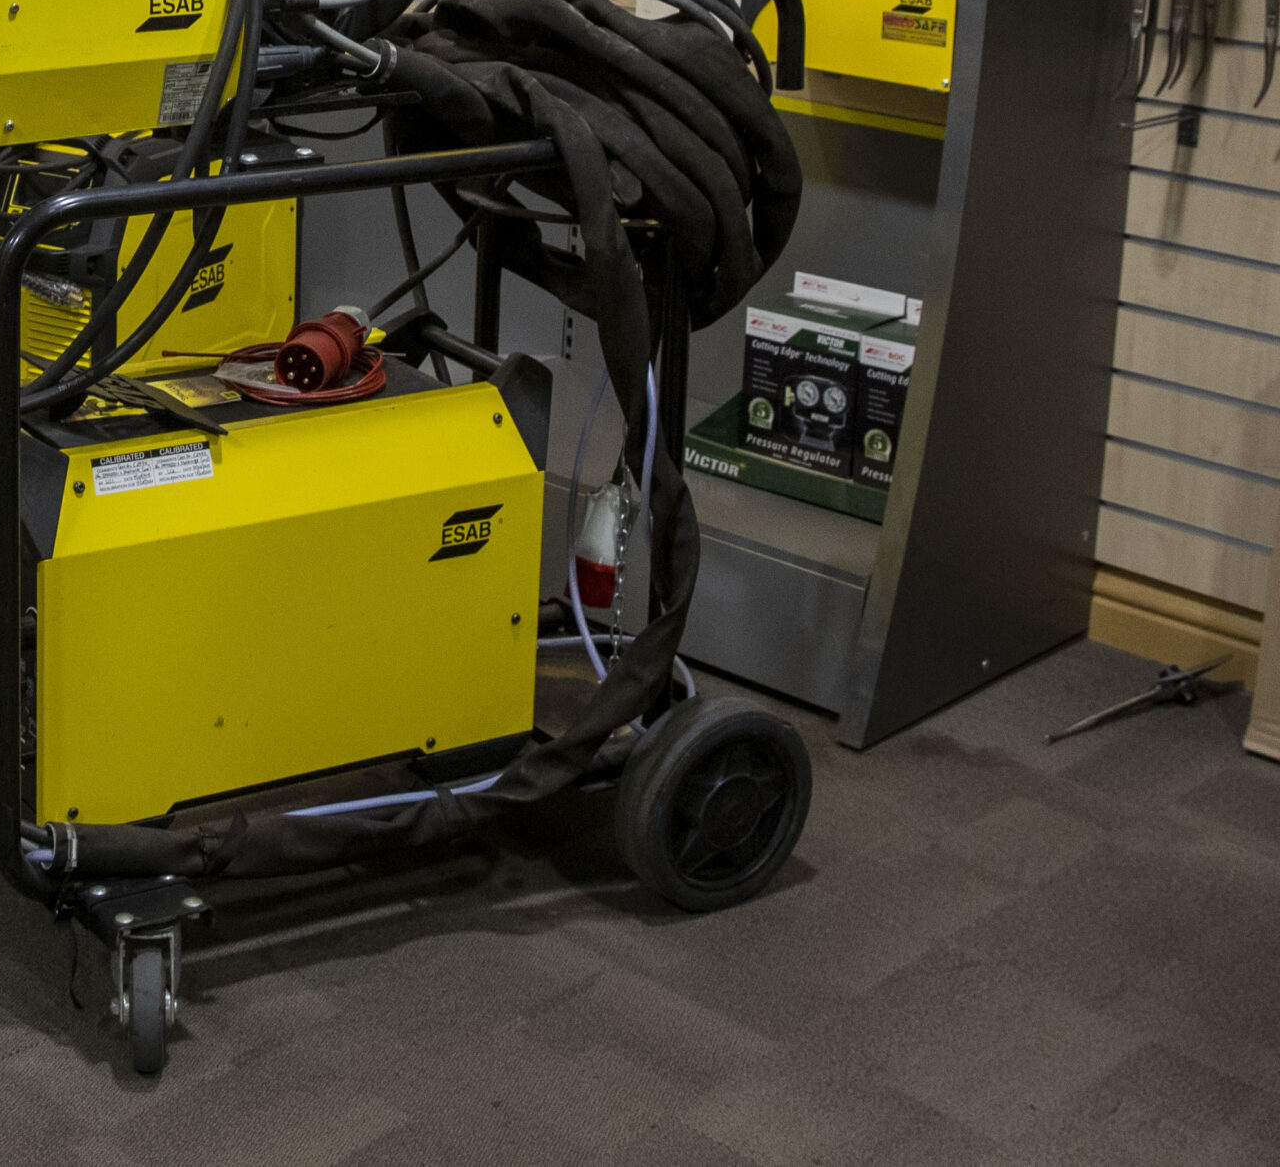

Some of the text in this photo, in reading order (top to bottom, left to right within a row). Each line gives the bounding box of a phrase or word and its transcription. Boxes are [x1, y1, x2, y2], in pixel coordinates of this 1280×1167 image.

[190, 263, 225, 292] ESAB
[751, 339, 851, 373] Cutting Edge Technology
[866, 367, 897, 387] Cutting
[100, 451, 145, 466] CALIBRATED
[159, 442, 204, 456] CALIBRATED
[683, 446, 740, 478] VICTOR
[746, 433, 789, 455] Pressure
[790, 445, 843, 469] Regulator
[441, 520, 492, 546] ESAB
